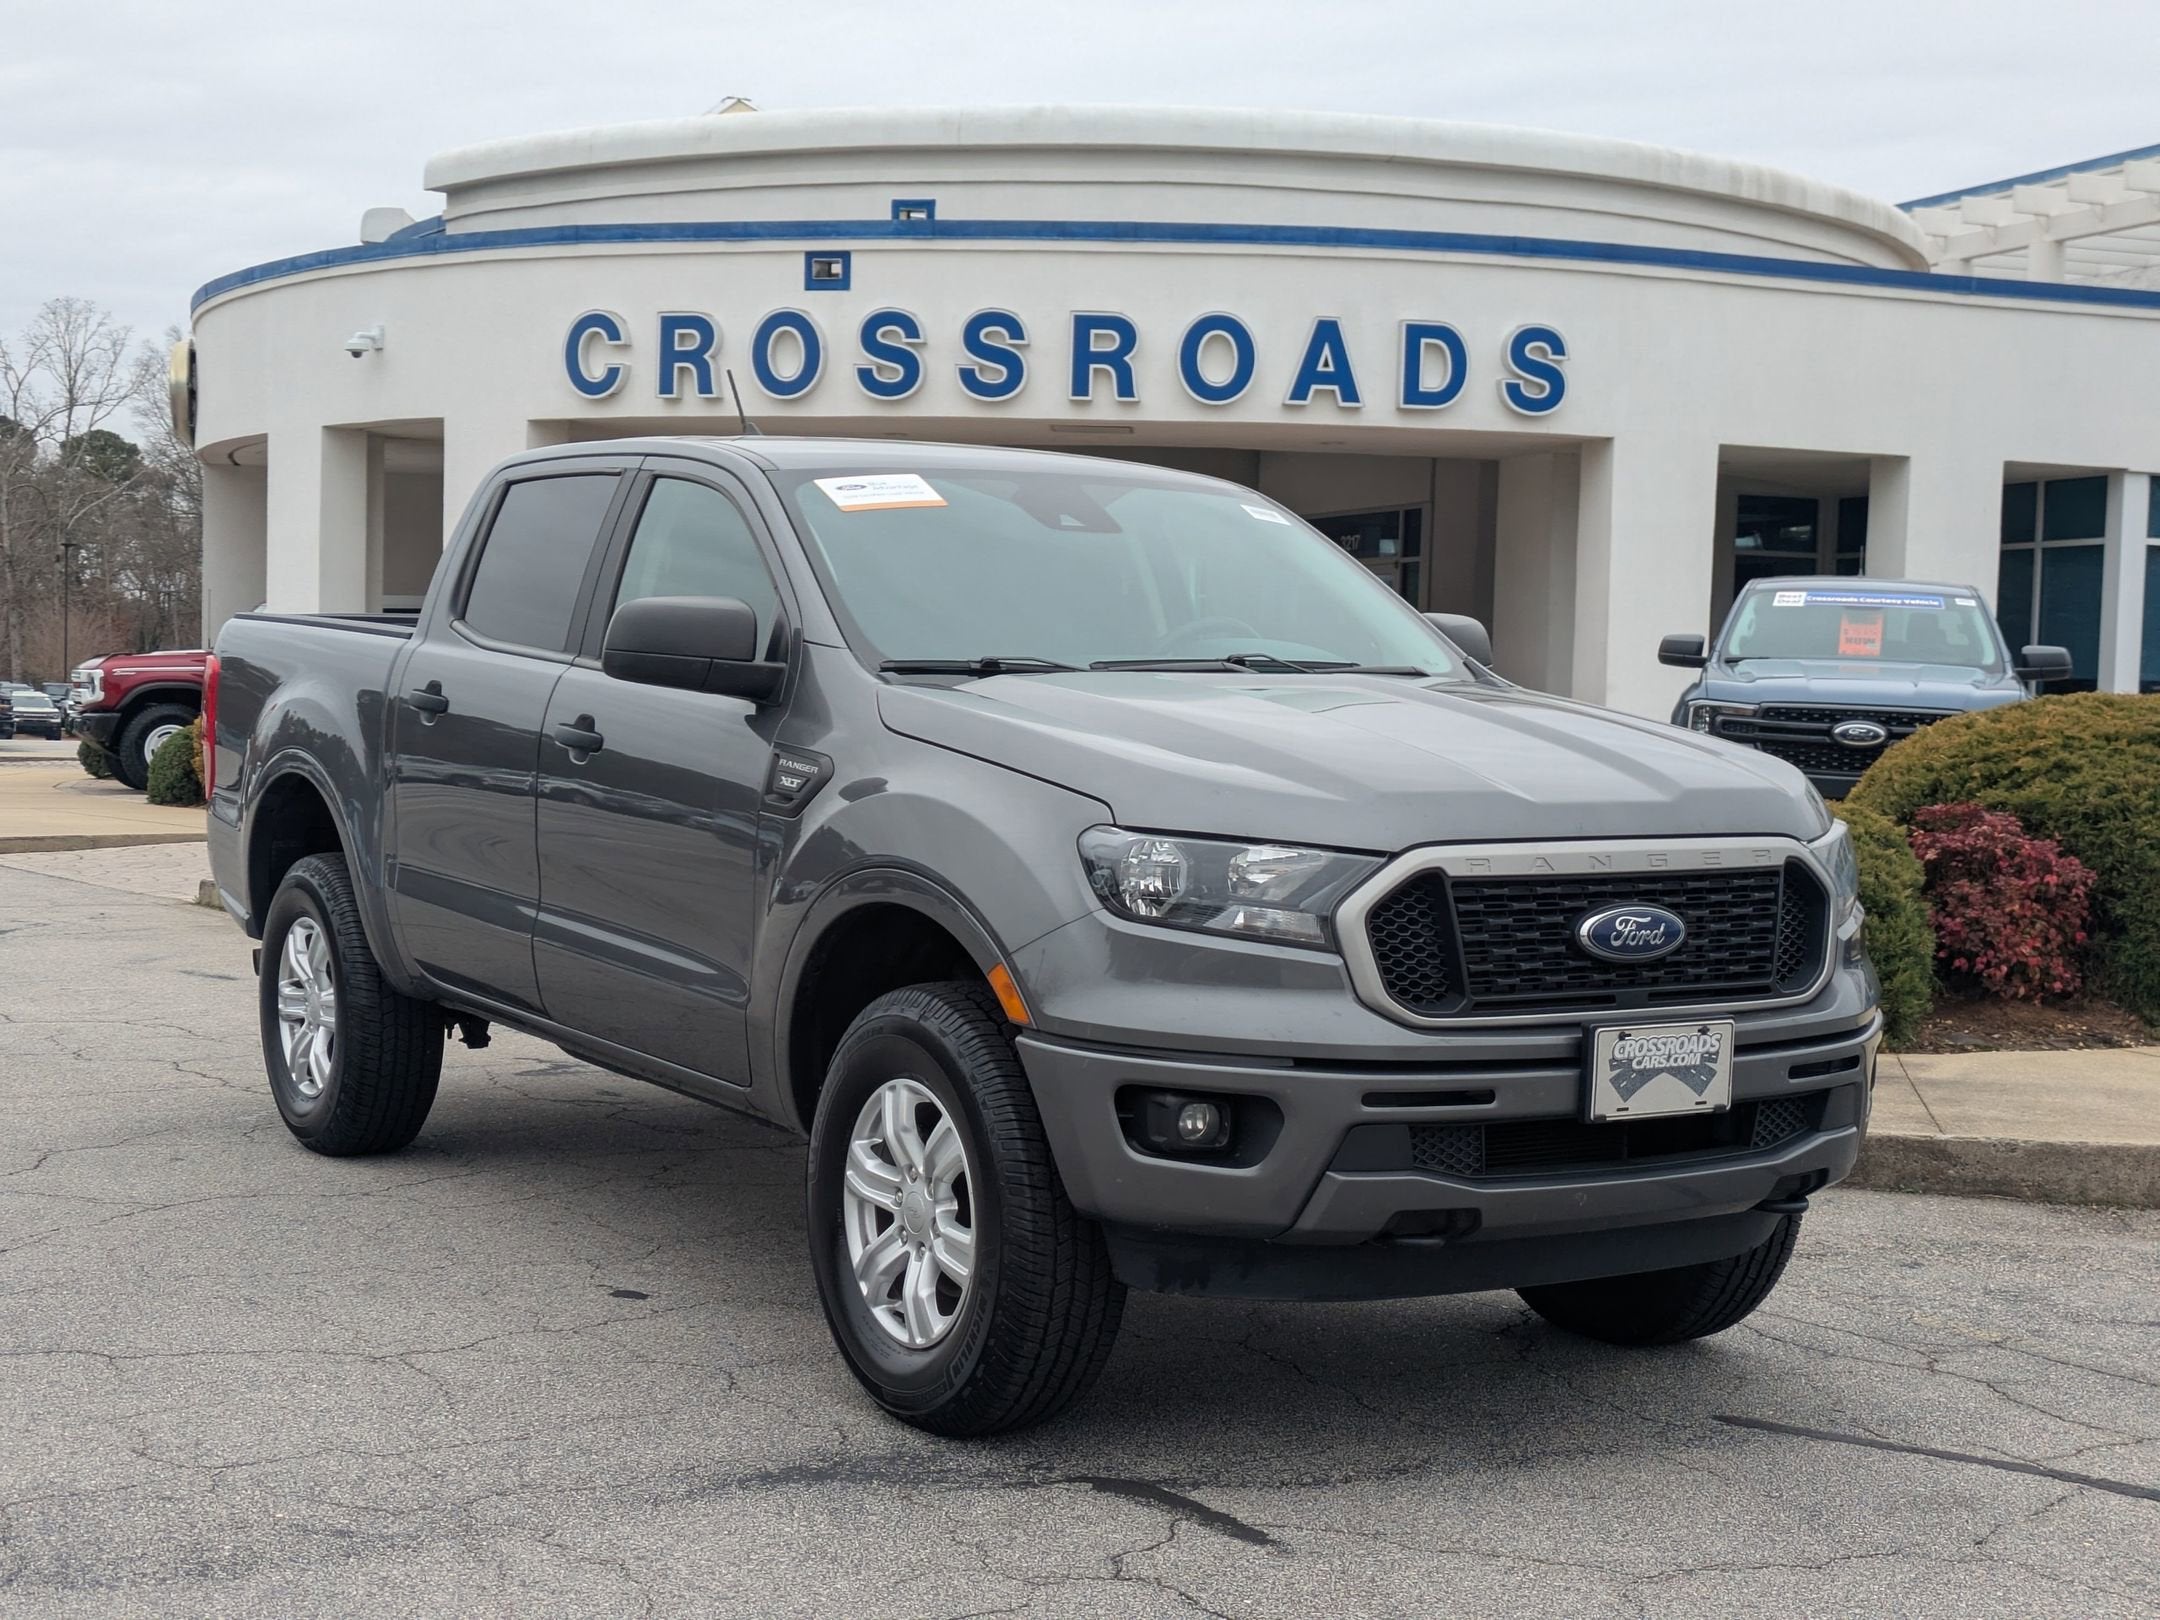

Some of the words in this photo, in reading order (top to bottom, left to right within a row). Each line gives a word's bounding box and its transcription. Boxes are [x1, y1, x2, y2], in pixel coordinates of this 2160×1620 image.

[563, 307, 1569, 416] CROSSROADS
[779, 758, 819, 774] RANGER
[779, 776, 802, 788] XLT
[1465, 849, 1771, 873] RANGER
[1610, 915, 1666, 947] Ford
[1612, 1033, 1722, 1060] CROSSROADS
[1631, 1053, 1702, 1070] CARS.COM
